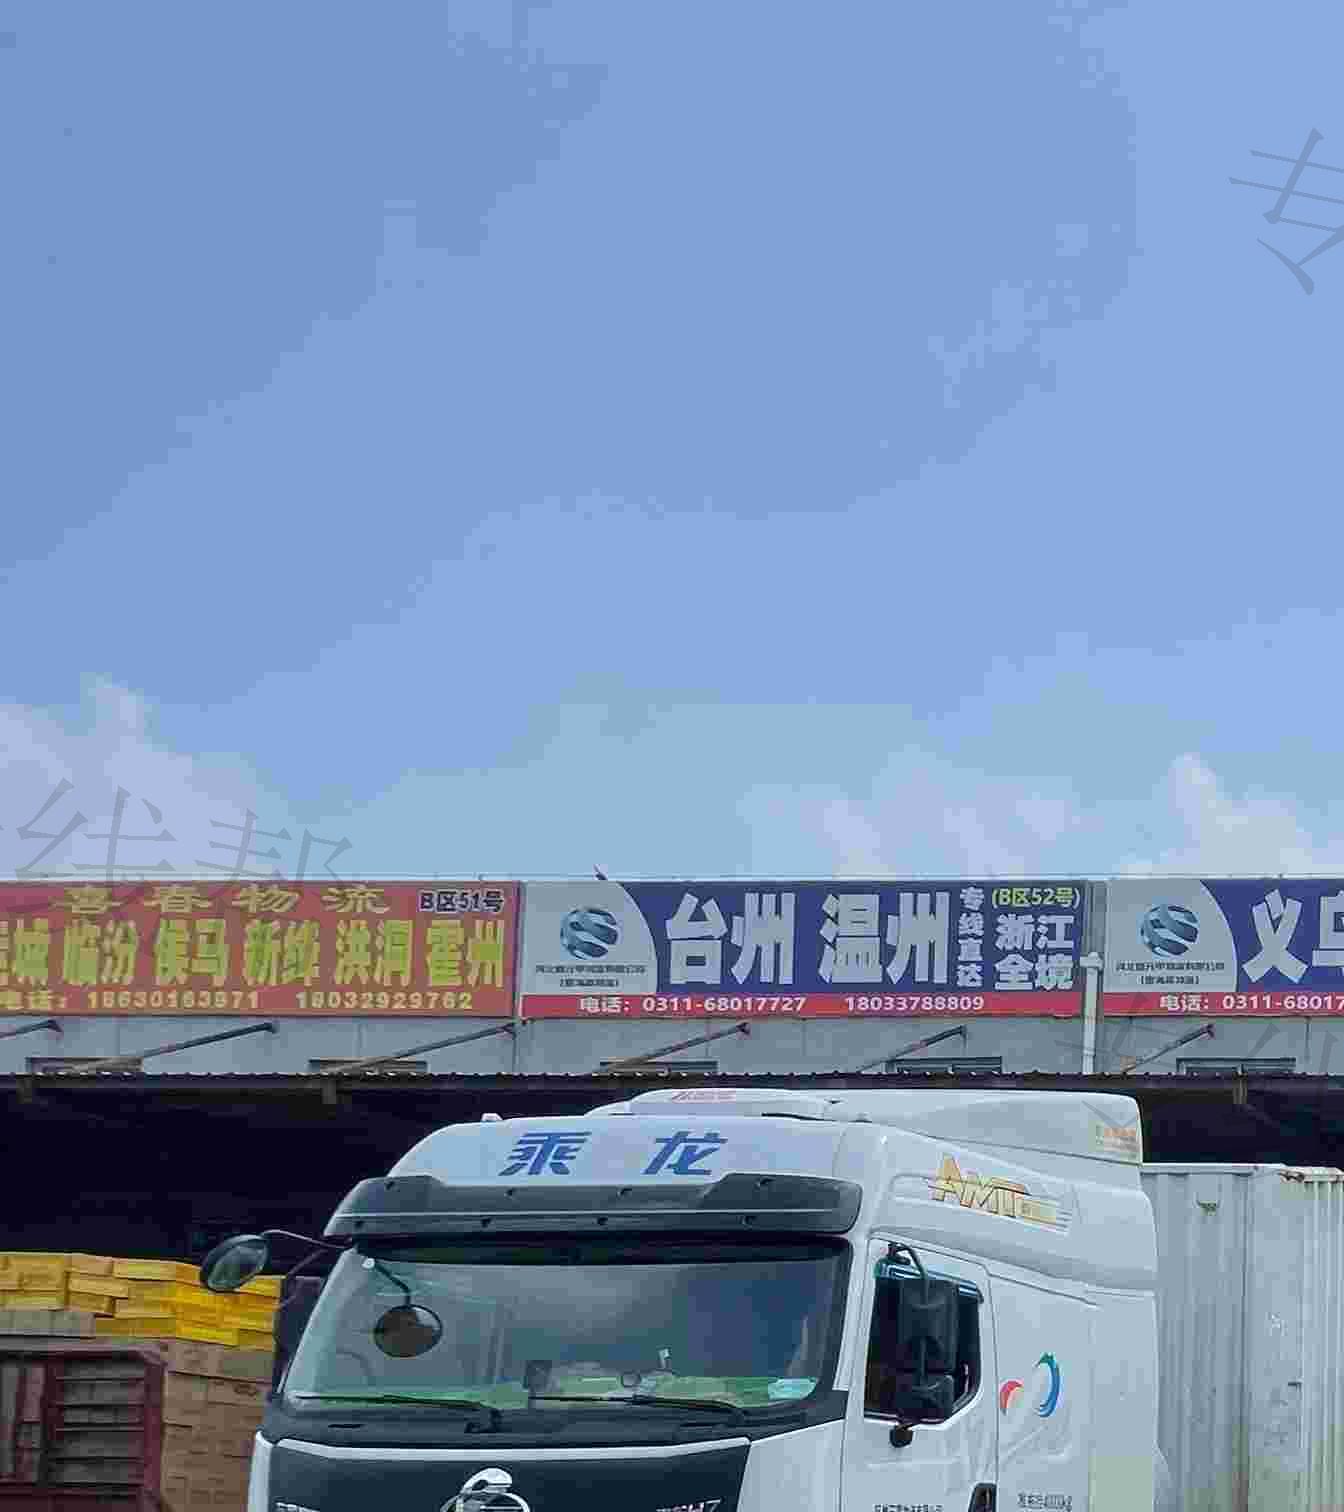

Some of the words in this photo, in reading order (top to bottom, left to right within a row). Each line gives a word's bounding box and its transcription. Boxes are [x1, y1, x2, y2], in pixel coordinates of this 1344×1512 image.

[418, 889, 504, 913] B区51号
[665, 892, 796, 985] 台州
[819, 892, 950, 985] 温州
[995, 914, 1075, 951] 浙江
[994, 953, 1074, 991] 全境
[642, 997, 808, 1012] 0311-68017727
[845, 996, 985, 1012] 18033788809
[497, 1130, 729, 1177] 乘龙
